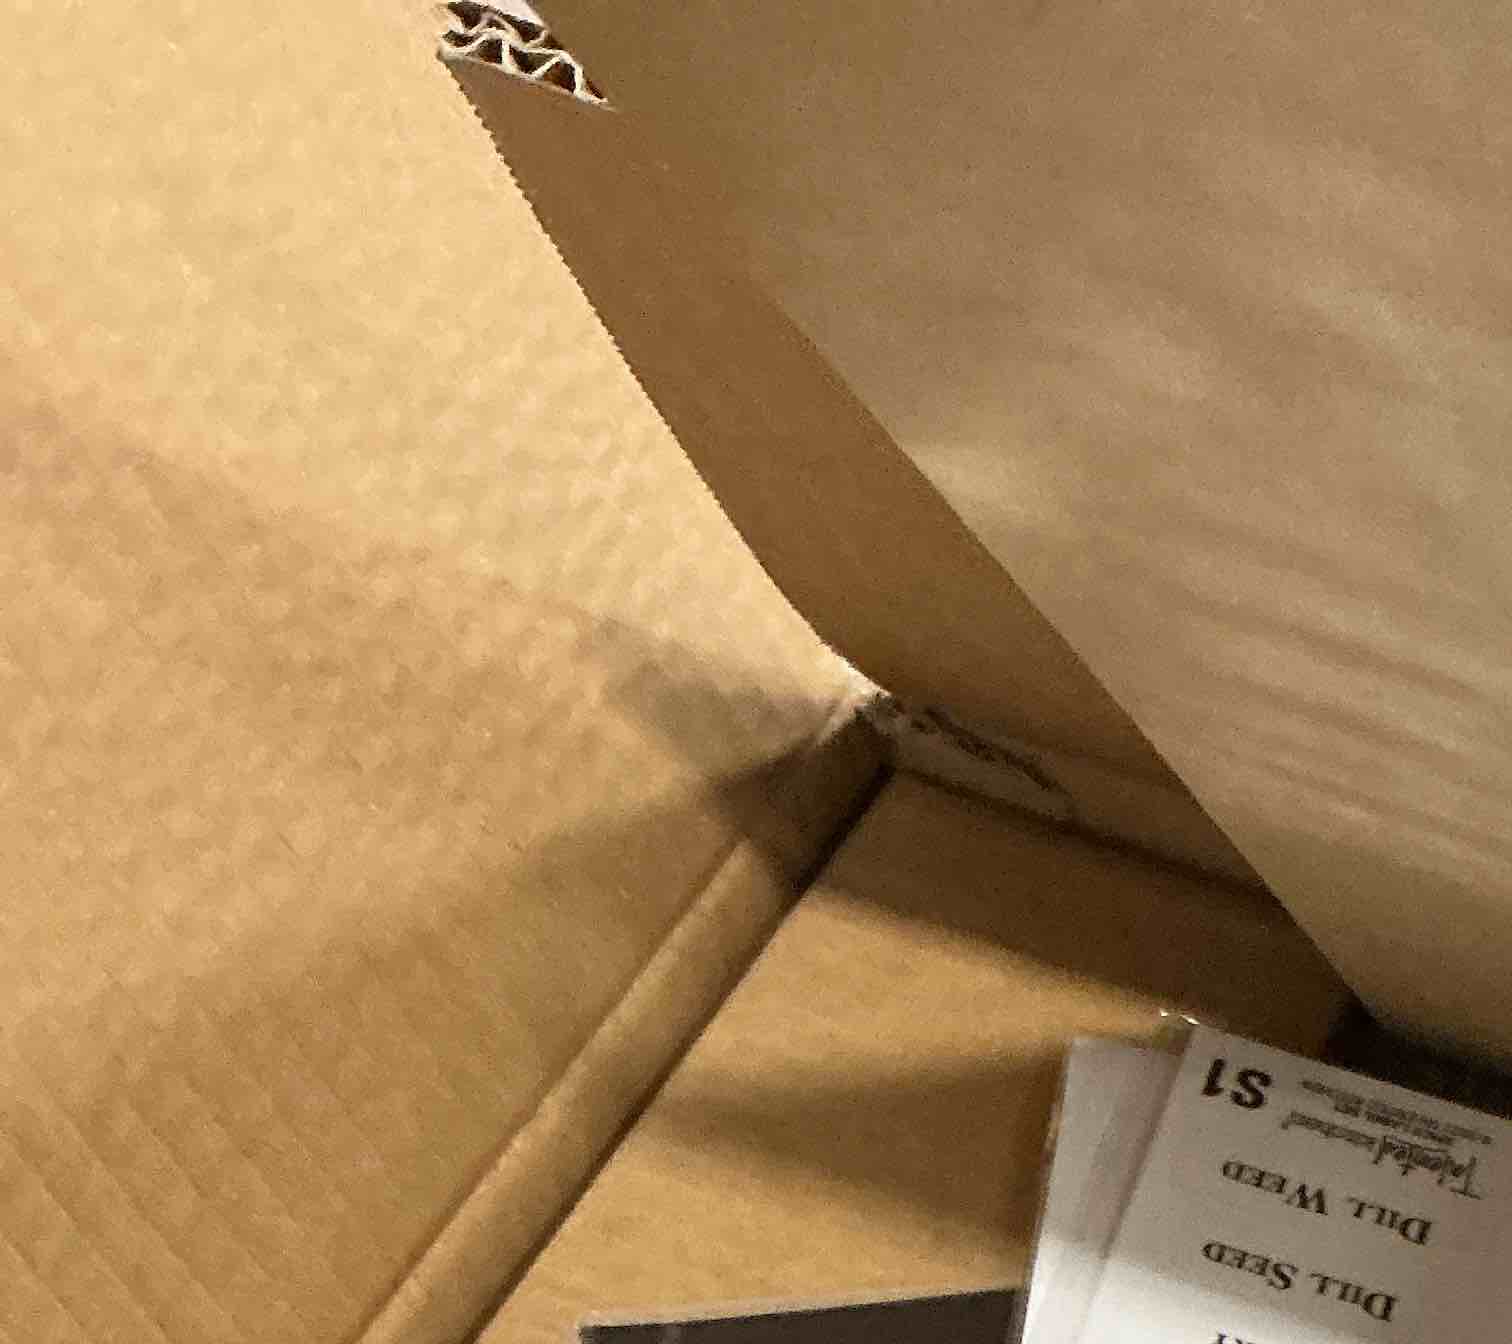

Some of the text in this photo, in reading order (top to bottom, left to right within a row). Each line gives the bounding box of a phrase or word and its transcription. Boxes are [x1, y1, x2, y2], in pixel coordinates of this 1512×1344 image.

[1203, 1059, 1271, 1109] S1
[1222, 1159, 1432, 1247] DILL WEED
[1202, 1239, 1399, 1323] DILL SEED
